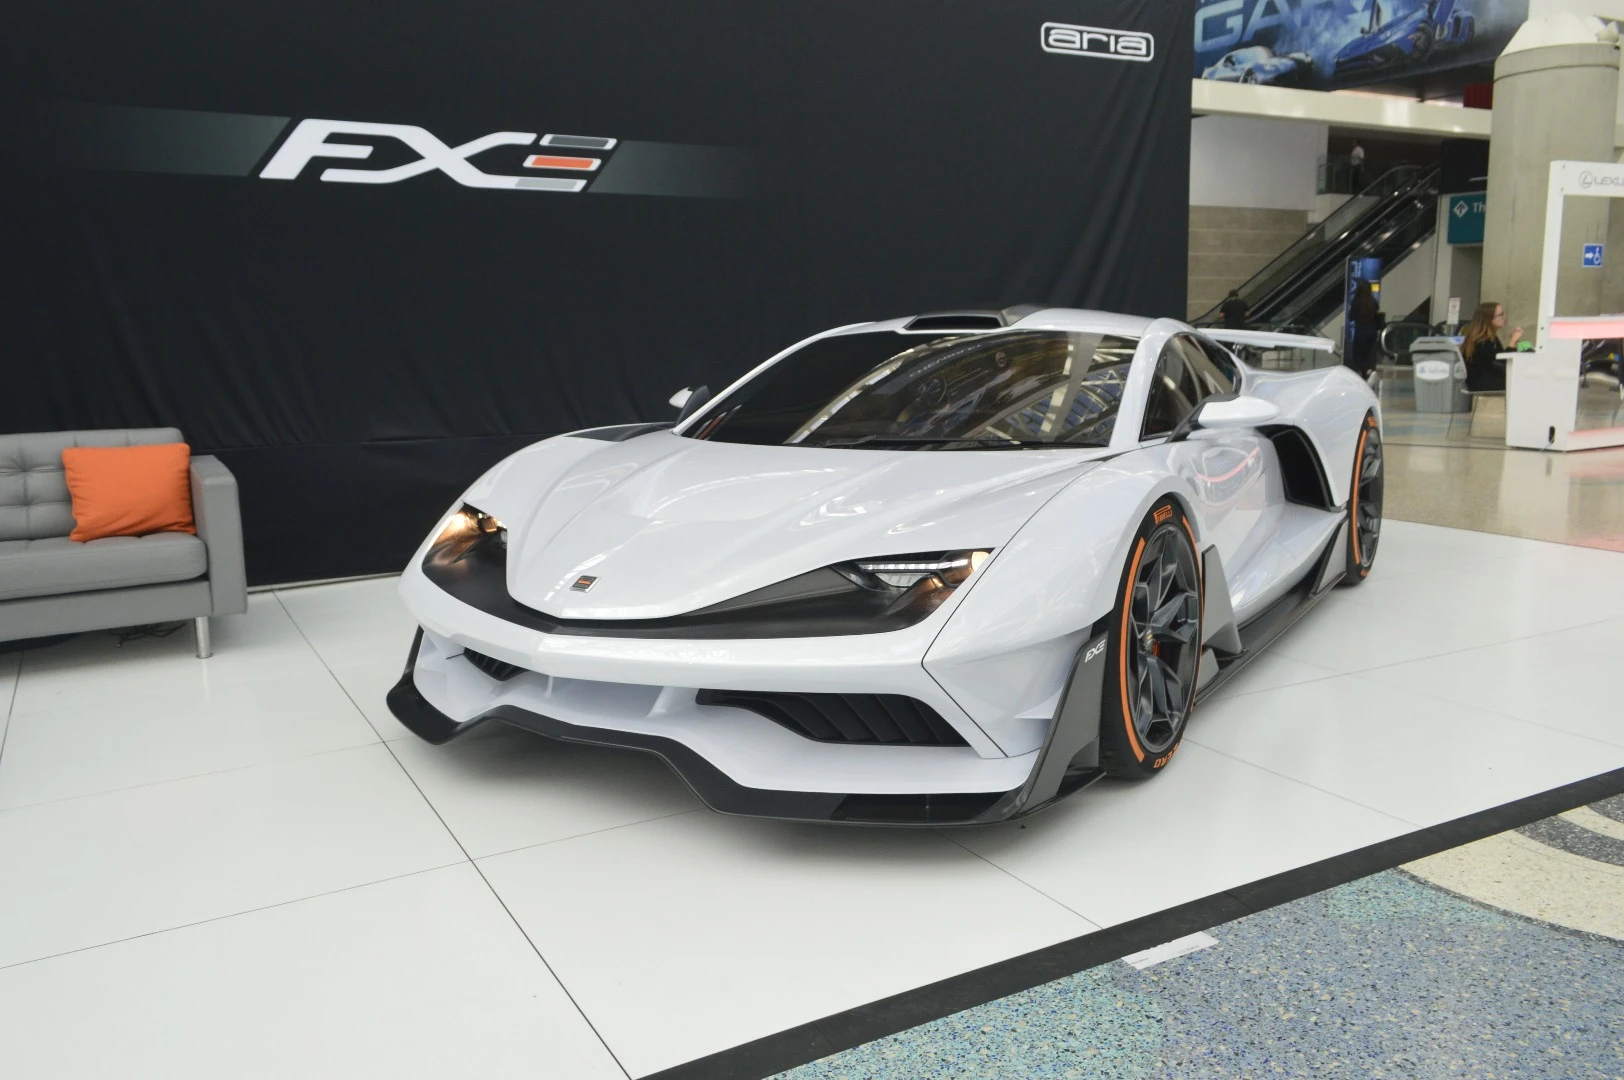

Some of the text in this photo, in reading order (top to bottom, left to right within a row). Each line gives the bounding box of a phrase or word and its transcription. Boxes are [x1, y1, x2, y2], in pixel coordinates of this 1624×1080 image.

[1048, 28, 1147, 56] aria
[259, 118, 617, 192] FXE
[1594, 175, 1624, 186] LEX
